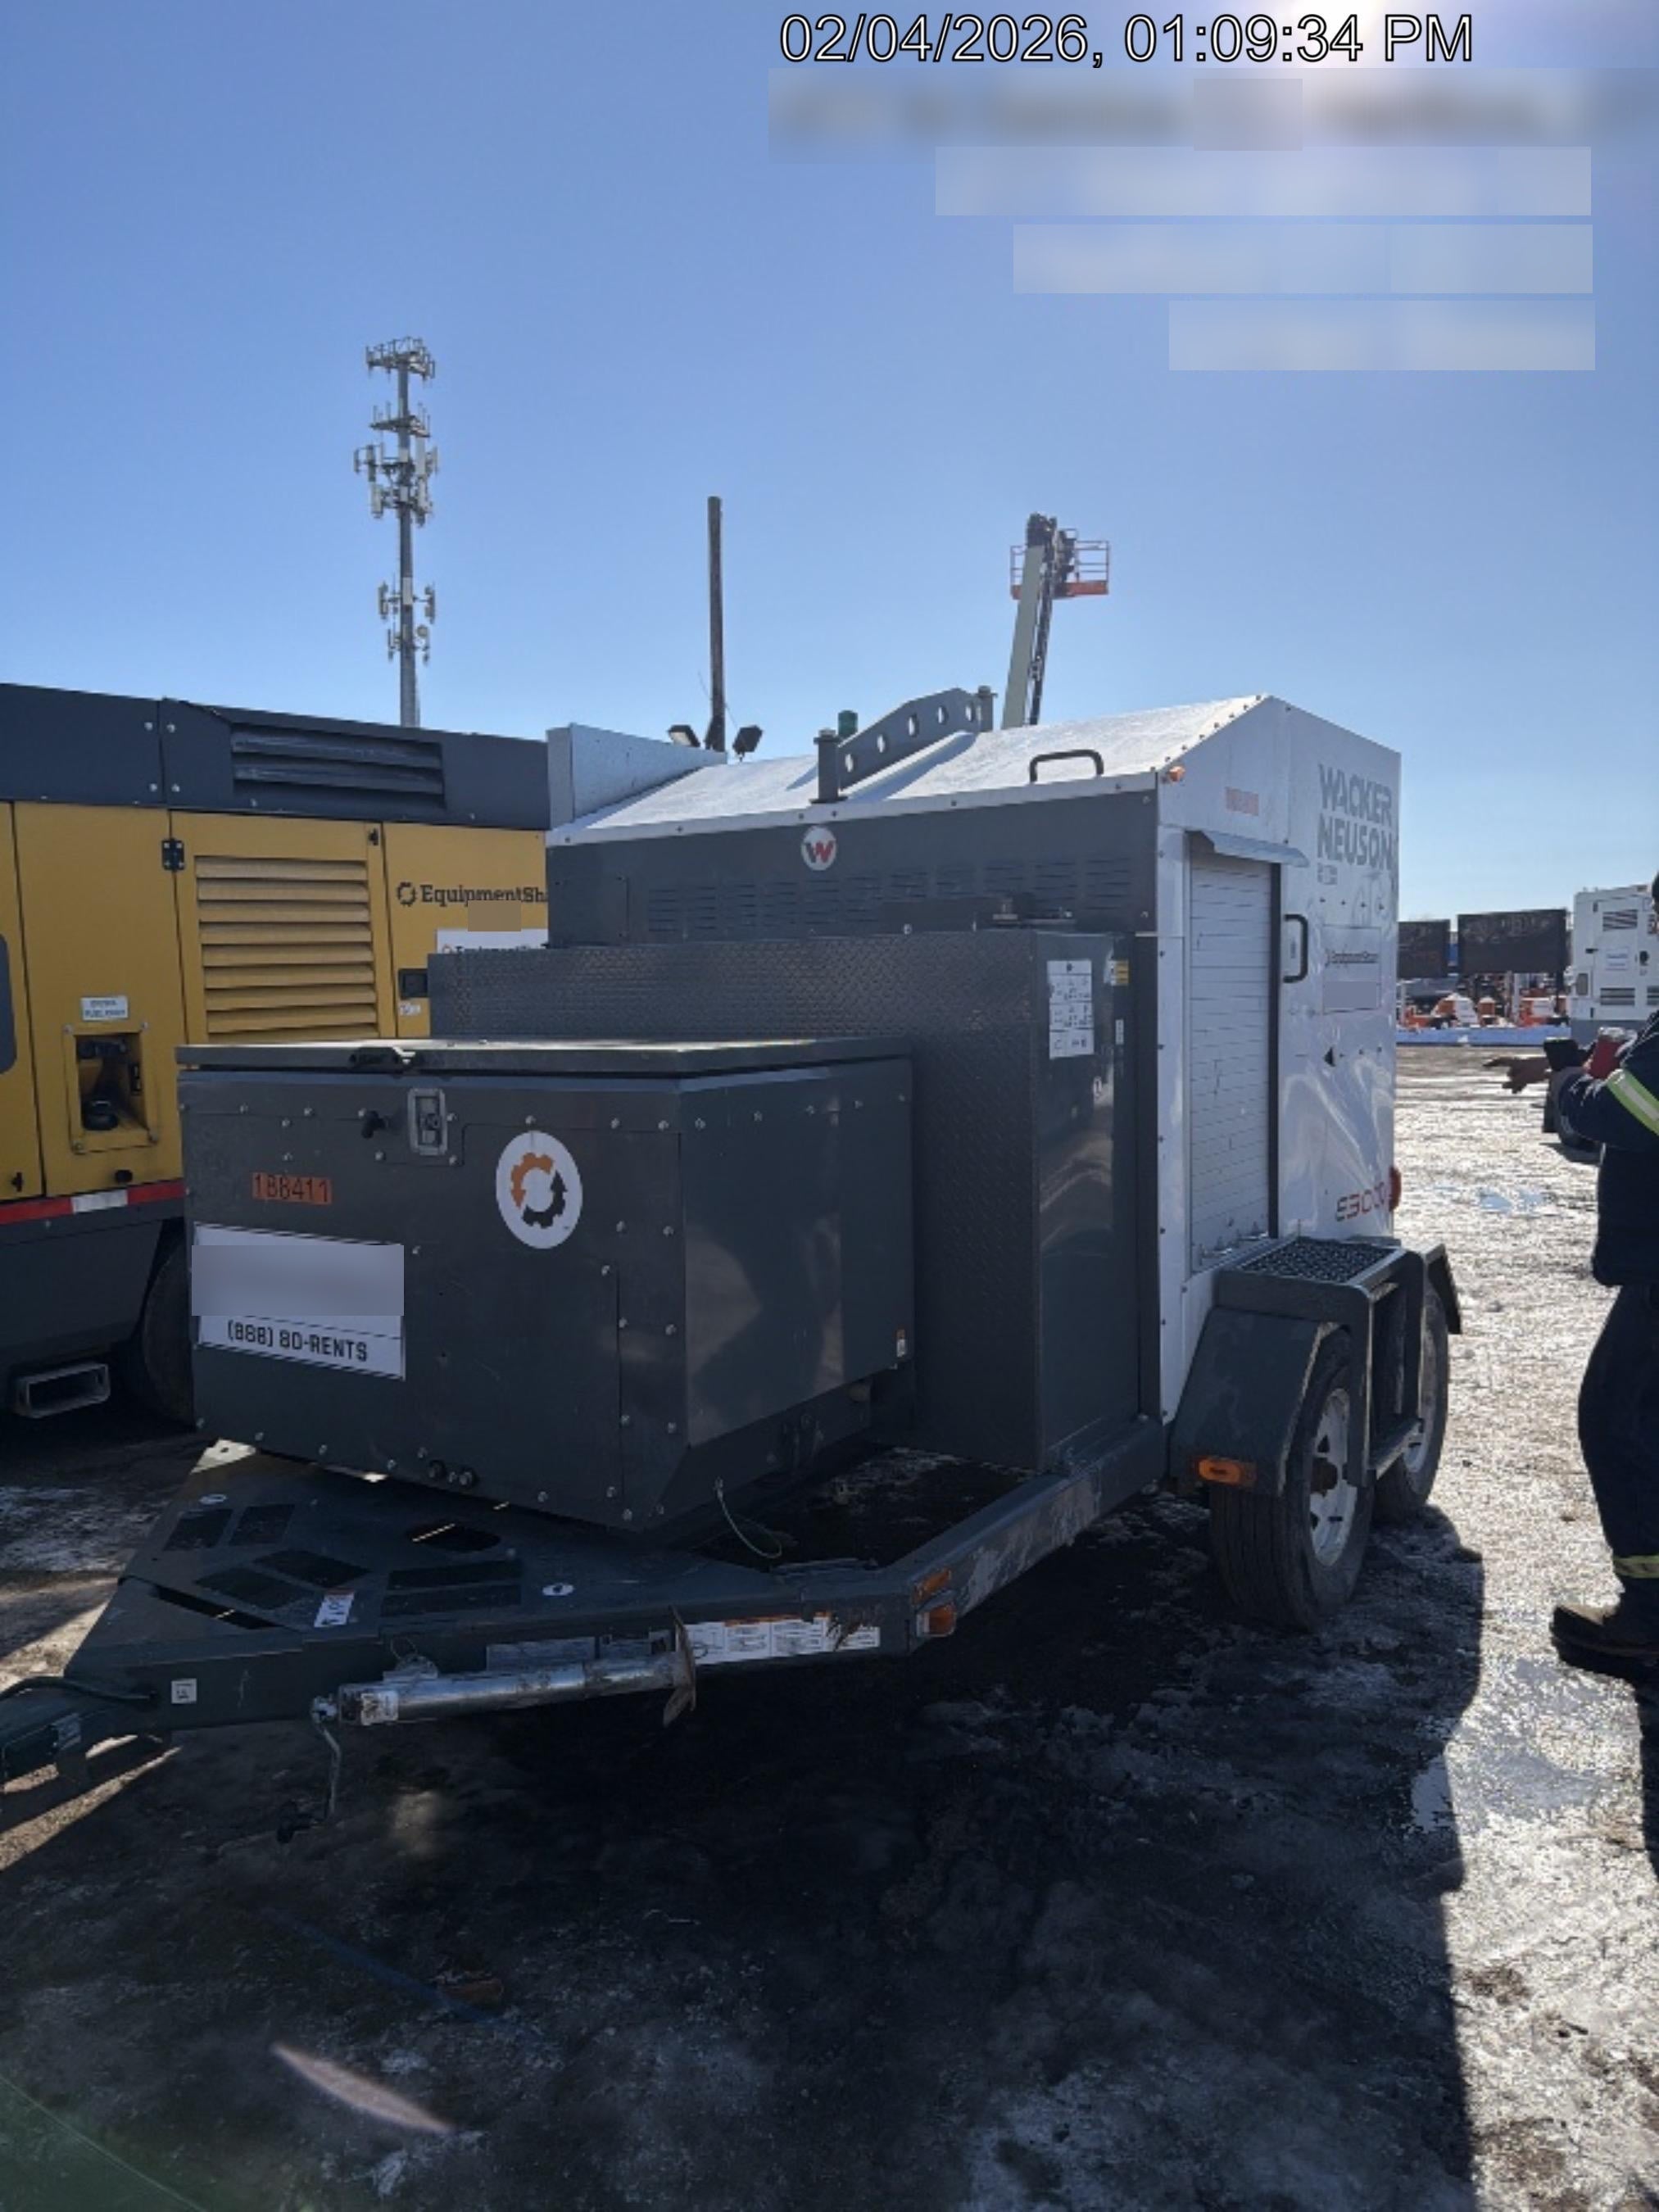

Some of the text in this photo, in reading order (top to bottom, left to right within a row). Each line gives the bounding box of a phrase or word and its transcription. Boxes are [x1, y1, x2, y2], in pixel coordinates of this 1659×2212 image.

[1318, 764, 1392, 827] WACKER
[1317, 813, 1393, 871] NEUSON
[228, 1320, 367, 1362] (888) 80-RENTS
